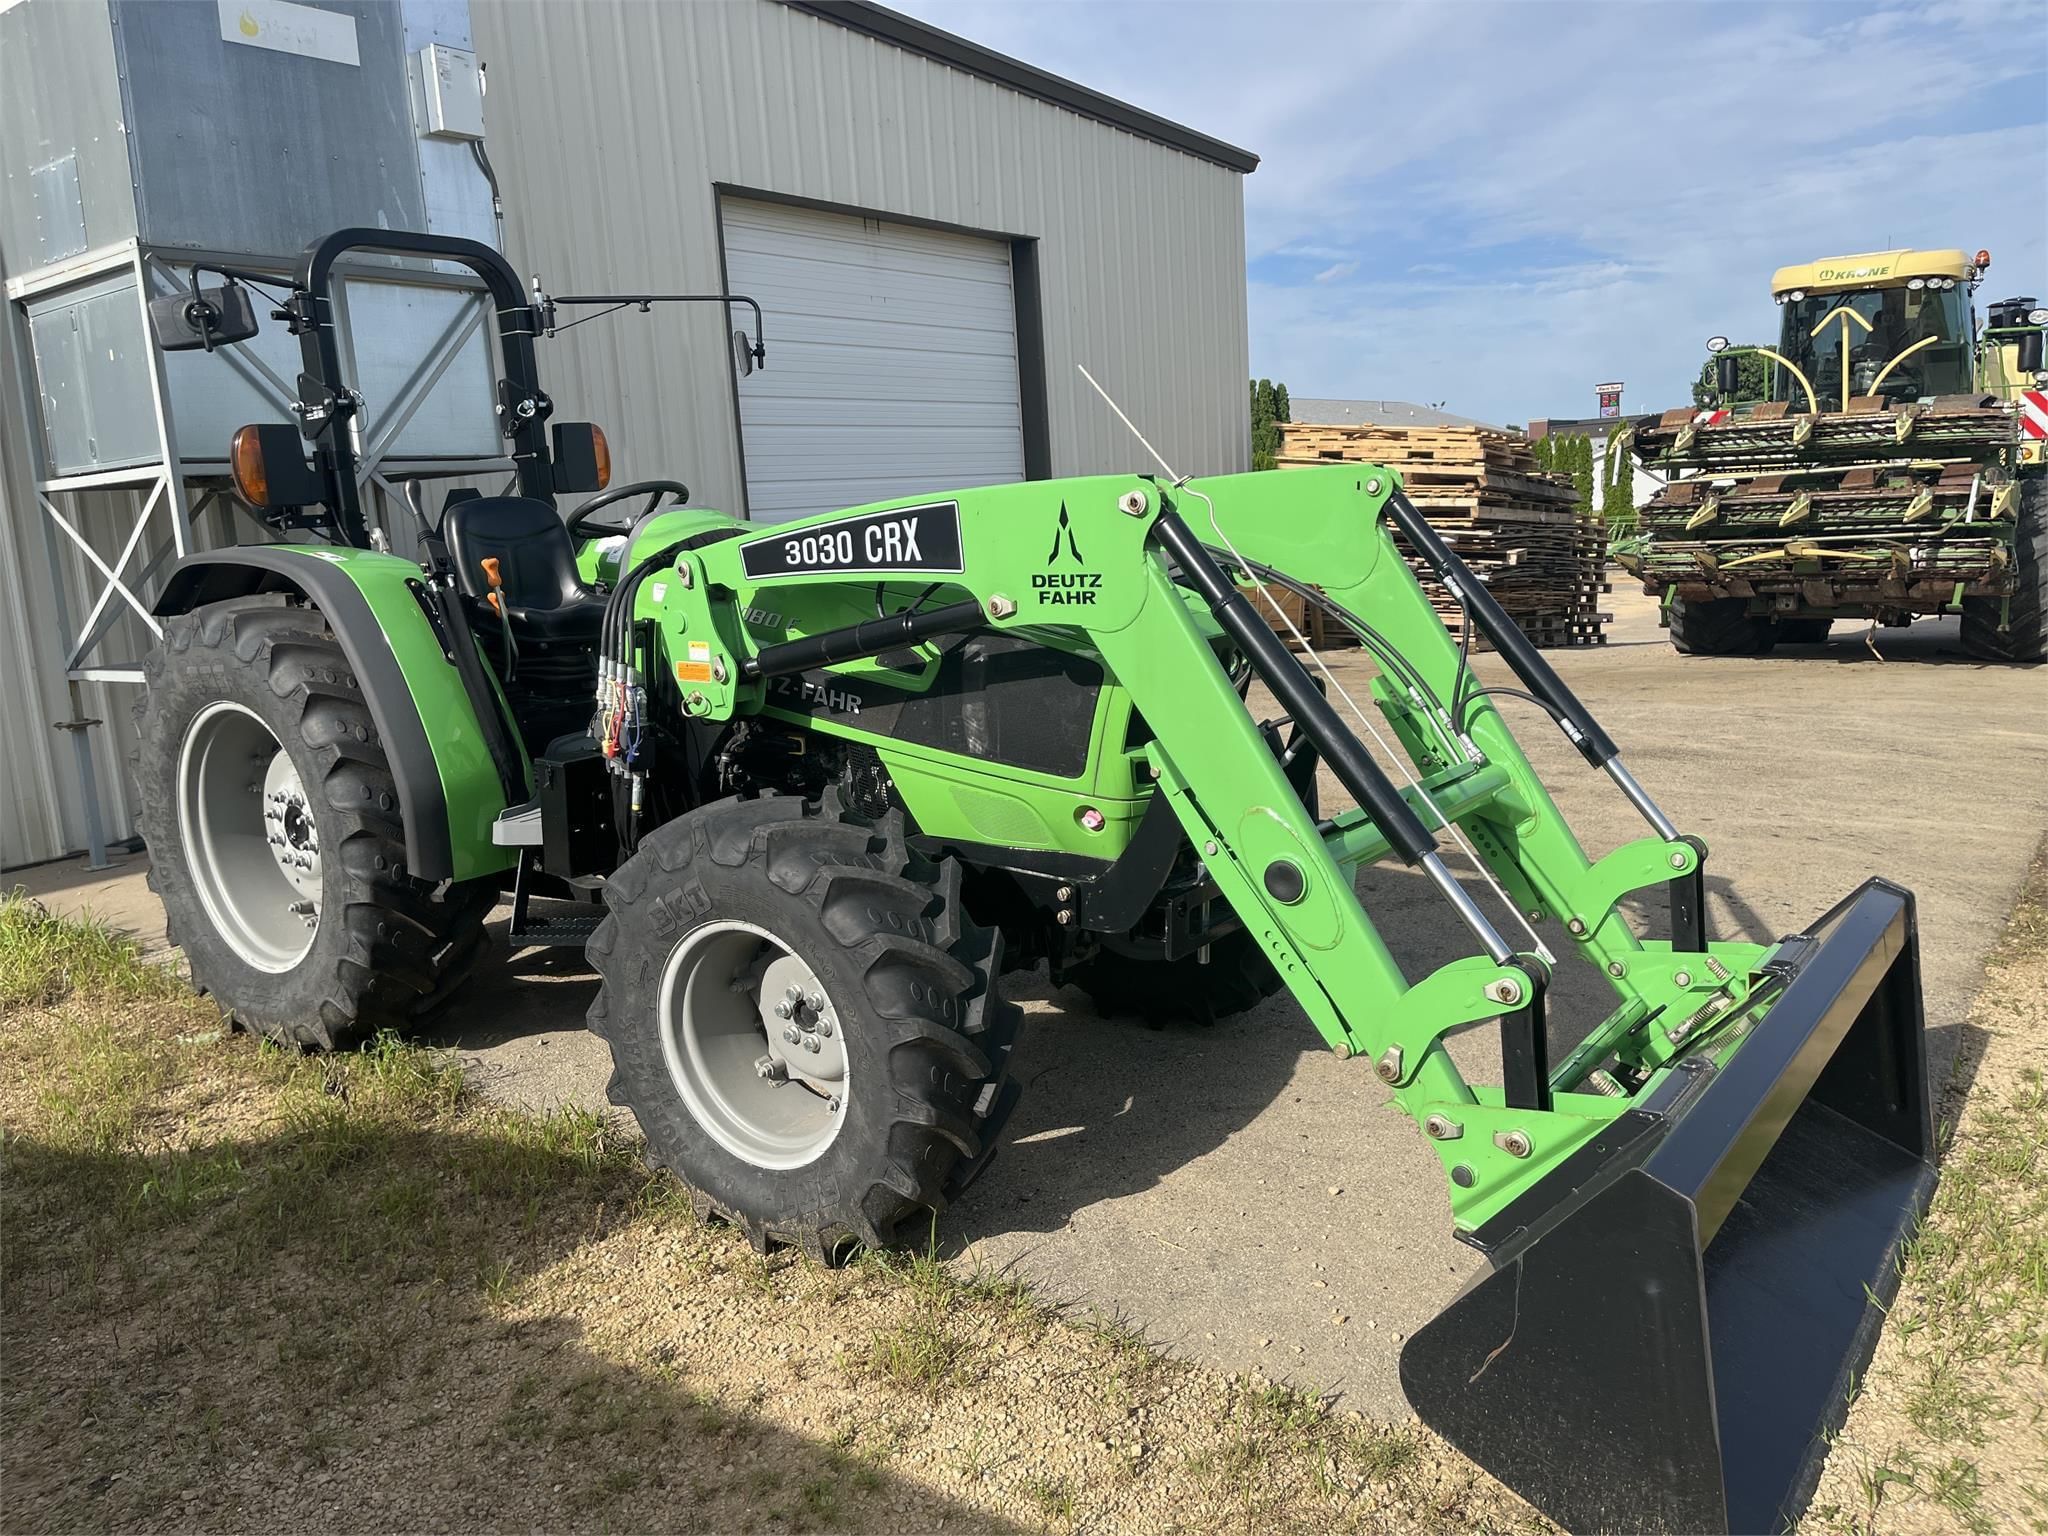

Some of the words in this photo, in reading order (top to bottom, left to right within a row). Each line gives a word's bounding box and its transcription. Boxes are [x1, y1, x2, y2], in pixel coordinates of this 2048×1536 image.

[1834, 266, 1890, 280] KRONE
[785, 530, 854, 565] 3030
[865, 517, 922, 563] CRX
[1032, 574, 1102, 588] DEUTZ
[1039, 591, 1096, 605] FAHR
[646, 882, 709, 934] BKT
